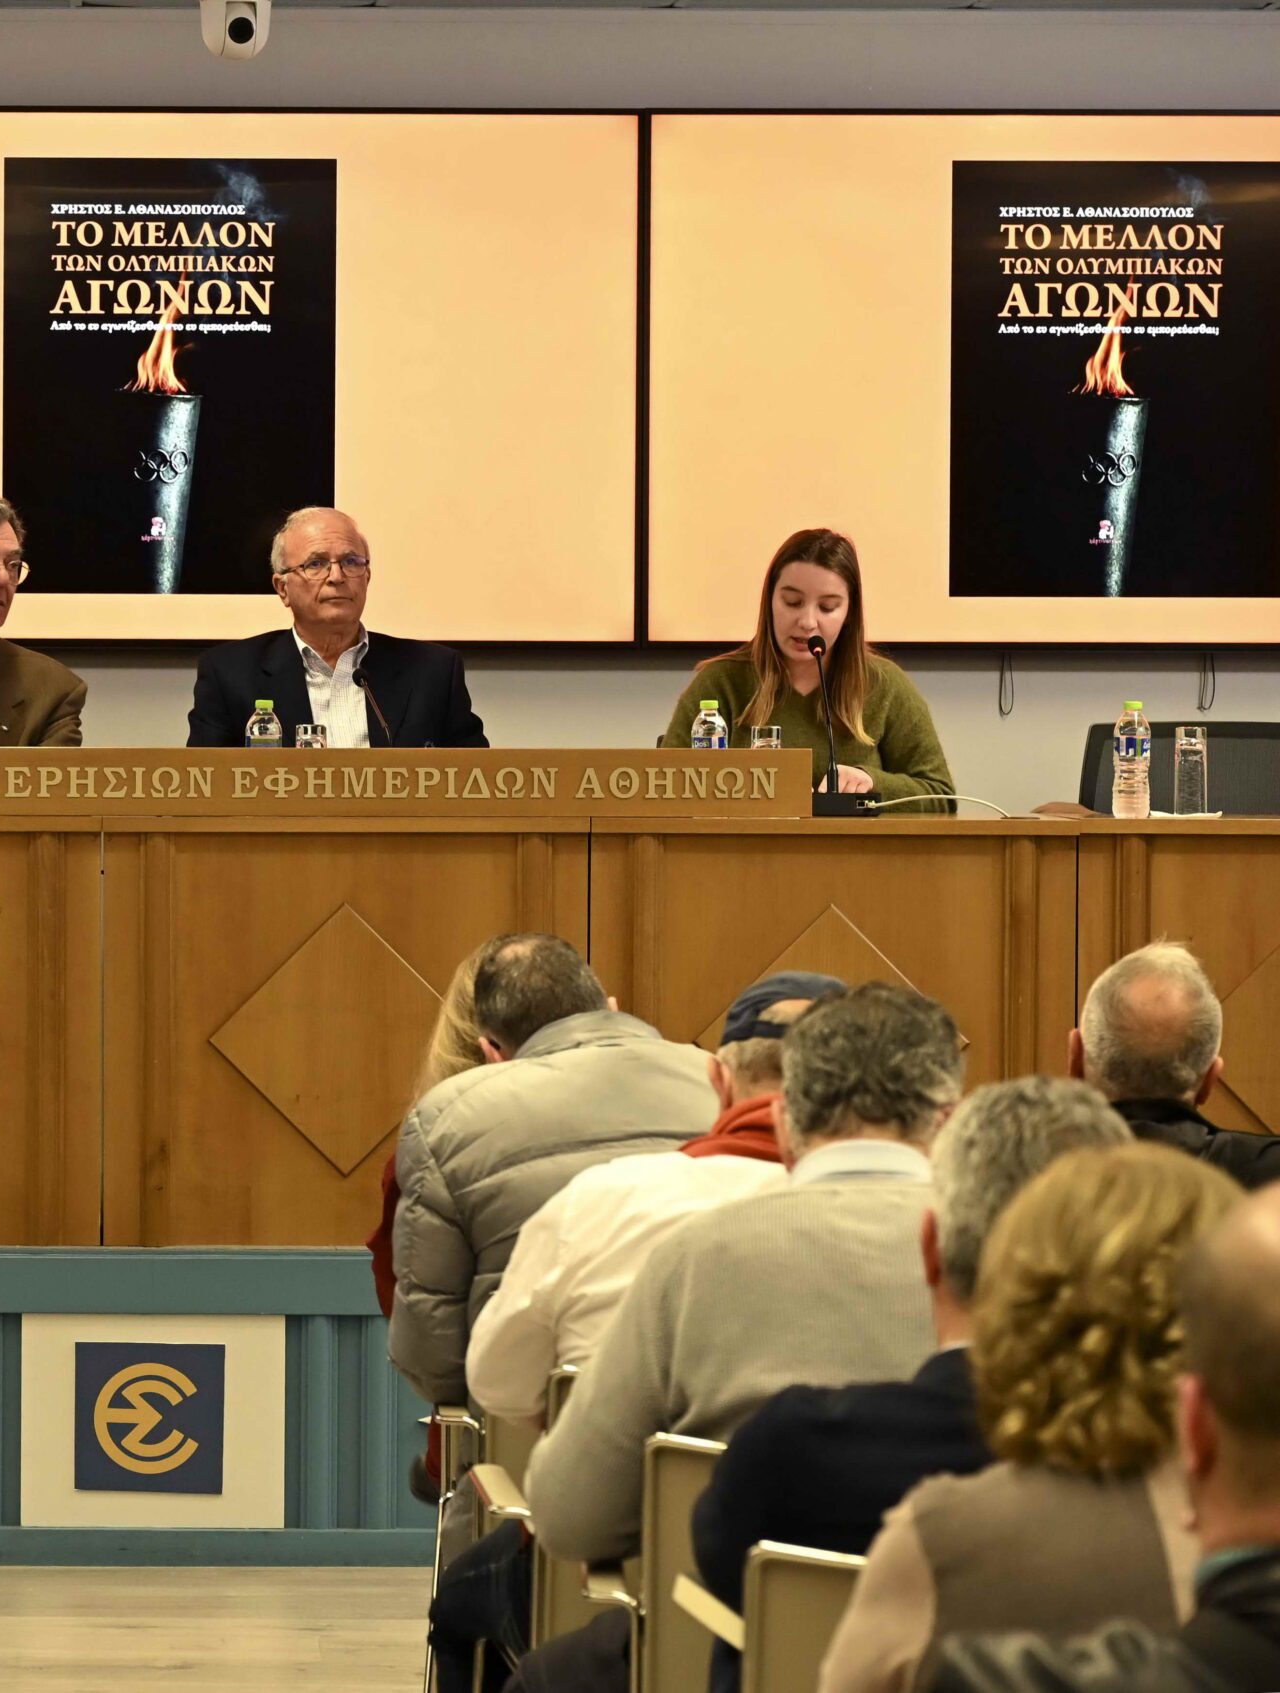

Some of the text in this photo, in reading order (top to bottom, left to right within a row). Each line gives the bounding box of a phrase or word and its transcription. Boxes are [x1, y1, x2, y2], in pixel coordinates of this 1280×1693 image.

[51, 204, 245, 215] ΧΡΗΣΤΟΣ Ε. ΑΘΑΝΑΣΟΠΟΥΛΟΣ
[1000, 207, 1194, 217] ΧΡΗΣΤΟΣ Ε. ΑΘΑΝΑΣΟΠΟΥΛΟΣ
[52, 221, 275, 247] ΤΟ ΜΕΛΛΟΝ
[1000, 224, 1223, 250] ΤΟ ΜΕΛΛΟΝ
[52, 255, 274, 272] ΤΩΝ ΟΛΥΜΠΙΑΚΩΝ
[1000, 258, 1223, 275] ΤΩΝ ΟΛΥΜΠΙΑΚΩΝ
[50, 280, 274, 314] ΑΓΩΝΩΝ
[998, 282, 1223, 318] ΑΓΩΝΩΝ
[50, 320, 72, 332] Από
[74, 323, 86, 331] το
[998, 323, 1020, 335] Από
[1022, 326, 1034, 334] το
[231, 766, 557, 799] ΕΦΗΜΕΡΙΔΩΝ
[575, 767, 778, 799] ΑΘΗΝΩΝ
